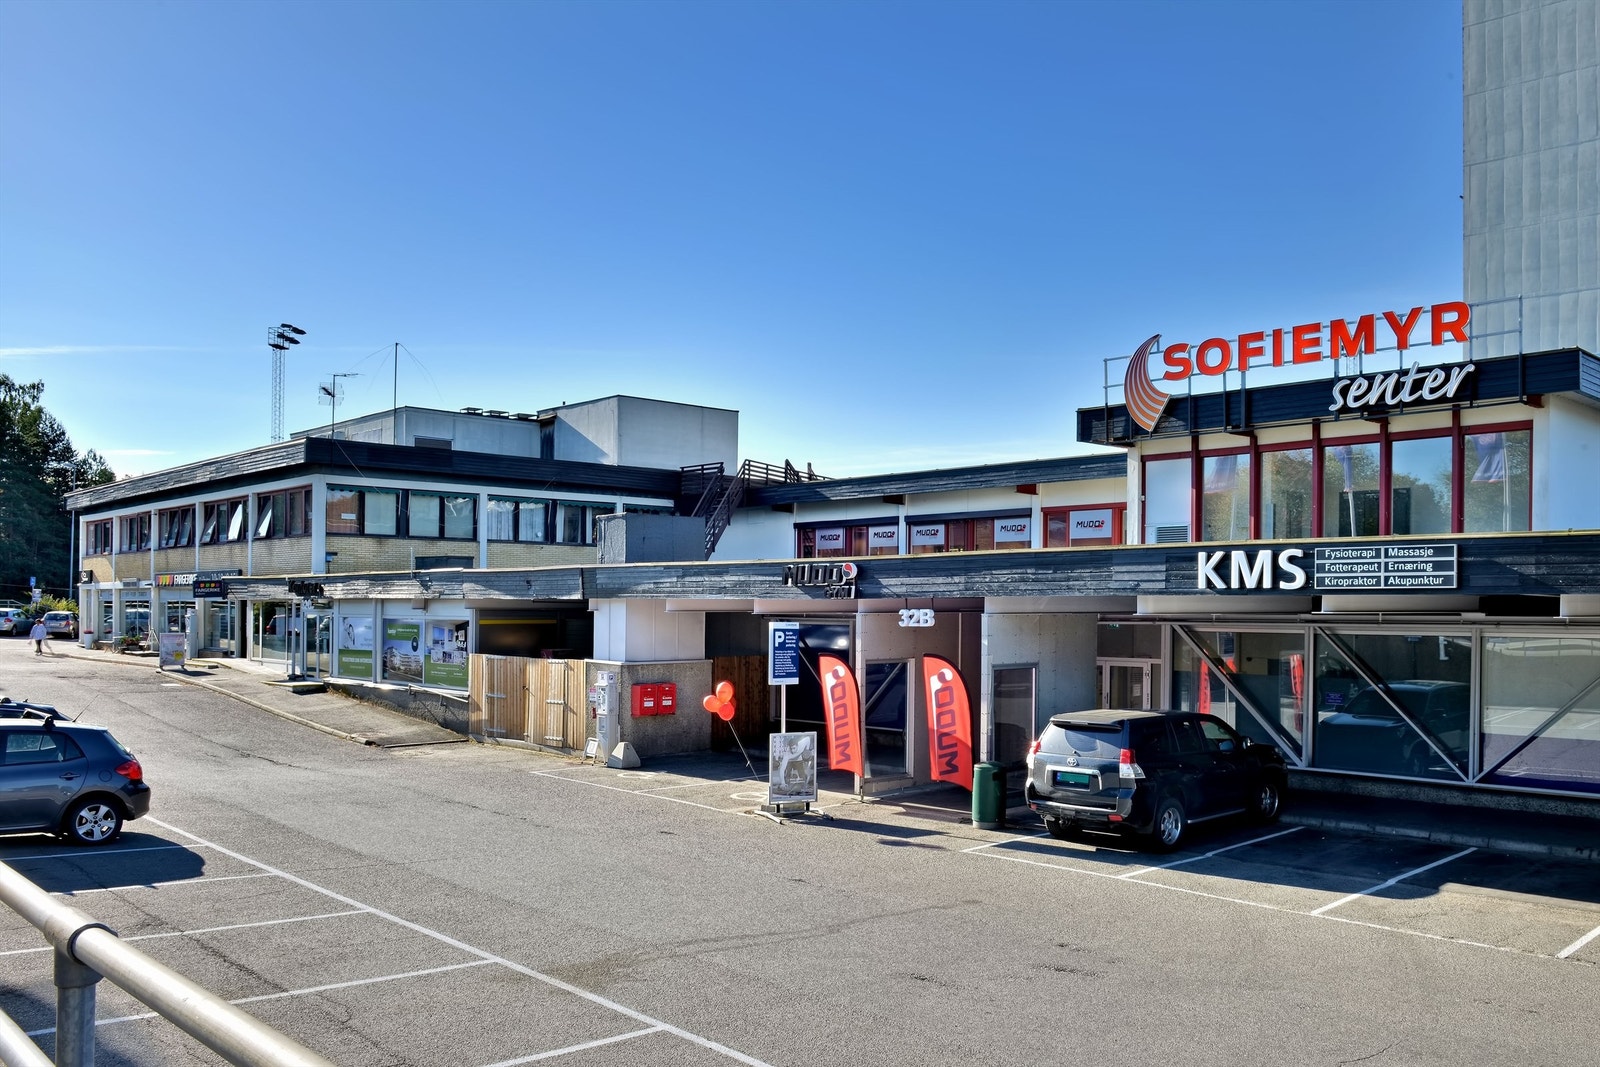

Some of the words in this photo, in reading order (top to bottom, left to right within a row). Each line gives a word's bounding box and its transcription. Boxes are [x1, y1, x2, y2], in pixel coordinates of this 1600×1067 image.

[1162, 301, 1472, 381] SOFIEMYR
[1329, 361, 1476, 411] senter
[1325, 548, 1376, 559] Fysioterapi
[1388, 547, 1434, 558] Massasje
[1198, 548, 1307, 590] KMS
[1325, 563, 1379, 572] Fotterapeut
[1388, 562, 1433, 571] Ernæring
[1324, 577, 1378, 587] Kiropraktor
[1388, 576, 1444, 586] Akupunktur
[898, 608, 936, 627] 32B
[774, 631, 785, 648] P
